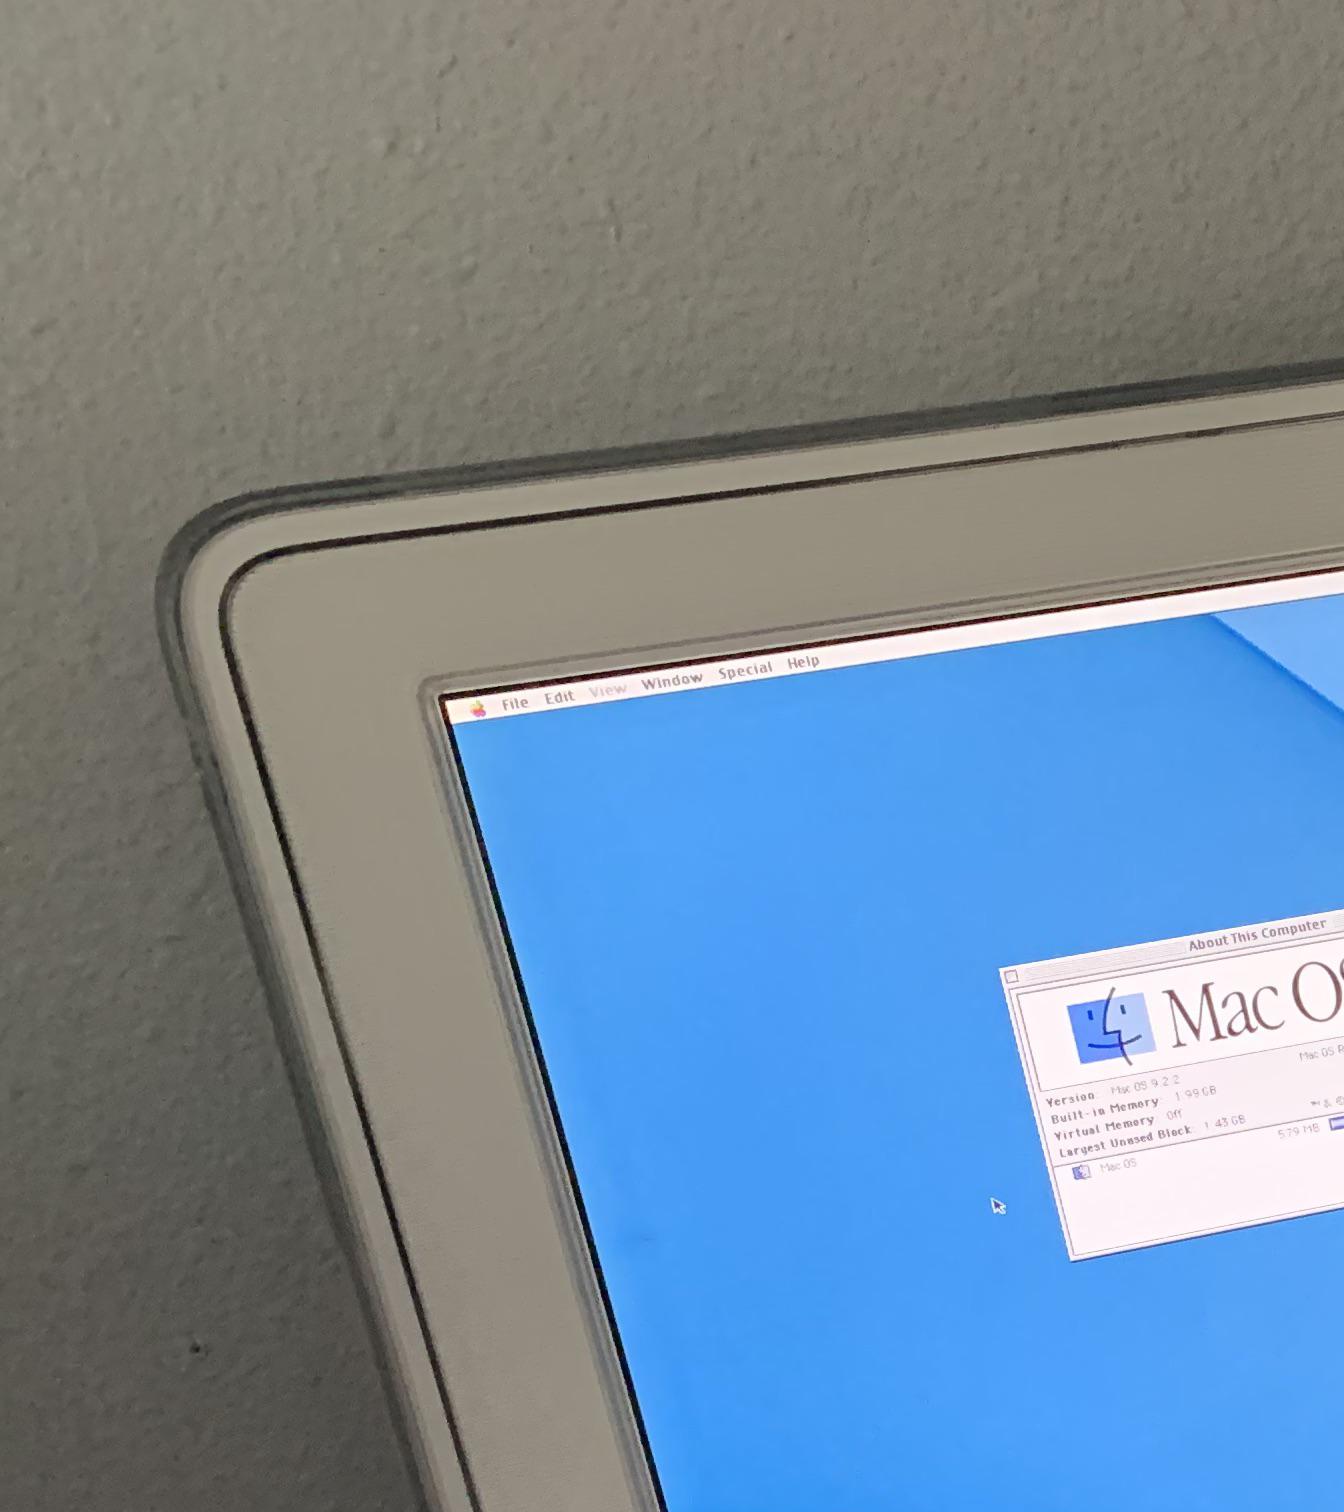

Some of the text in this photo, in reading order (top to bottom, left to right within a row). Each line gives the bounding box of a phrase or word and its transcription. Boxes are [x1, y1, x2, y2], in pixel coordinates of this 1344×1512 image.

[502, 654, 821, 712] File Edit View Window Special Help
[1189, 918, 1327, 952] About This Computer
[1162, 981, 1285, 1048] Mac
[1299, 1051, 1318, 1061] Mac
[1321, 1047, 1334, 1057] OS
[1111, 1084, 1129, 1095] Mac
[1151, 1074, 1180, 1088] 922
[1051, 1108, 1105, 1124] Built-in
[1175, 1088, 1199, 1101] 199
[1202, 1085, 1217, 1097] GB
[1054, 1124, 1100, 1141] Virtual
[1166, 1108, 1182, 1120] Off
[1060, 1141, 1106, 1158] Largest
[1110, 1132, 1154, 1148] Unused
[1231, 1114, 1246, 1126] GB
[1100, 1158, 1137, 1173] Mac OS
